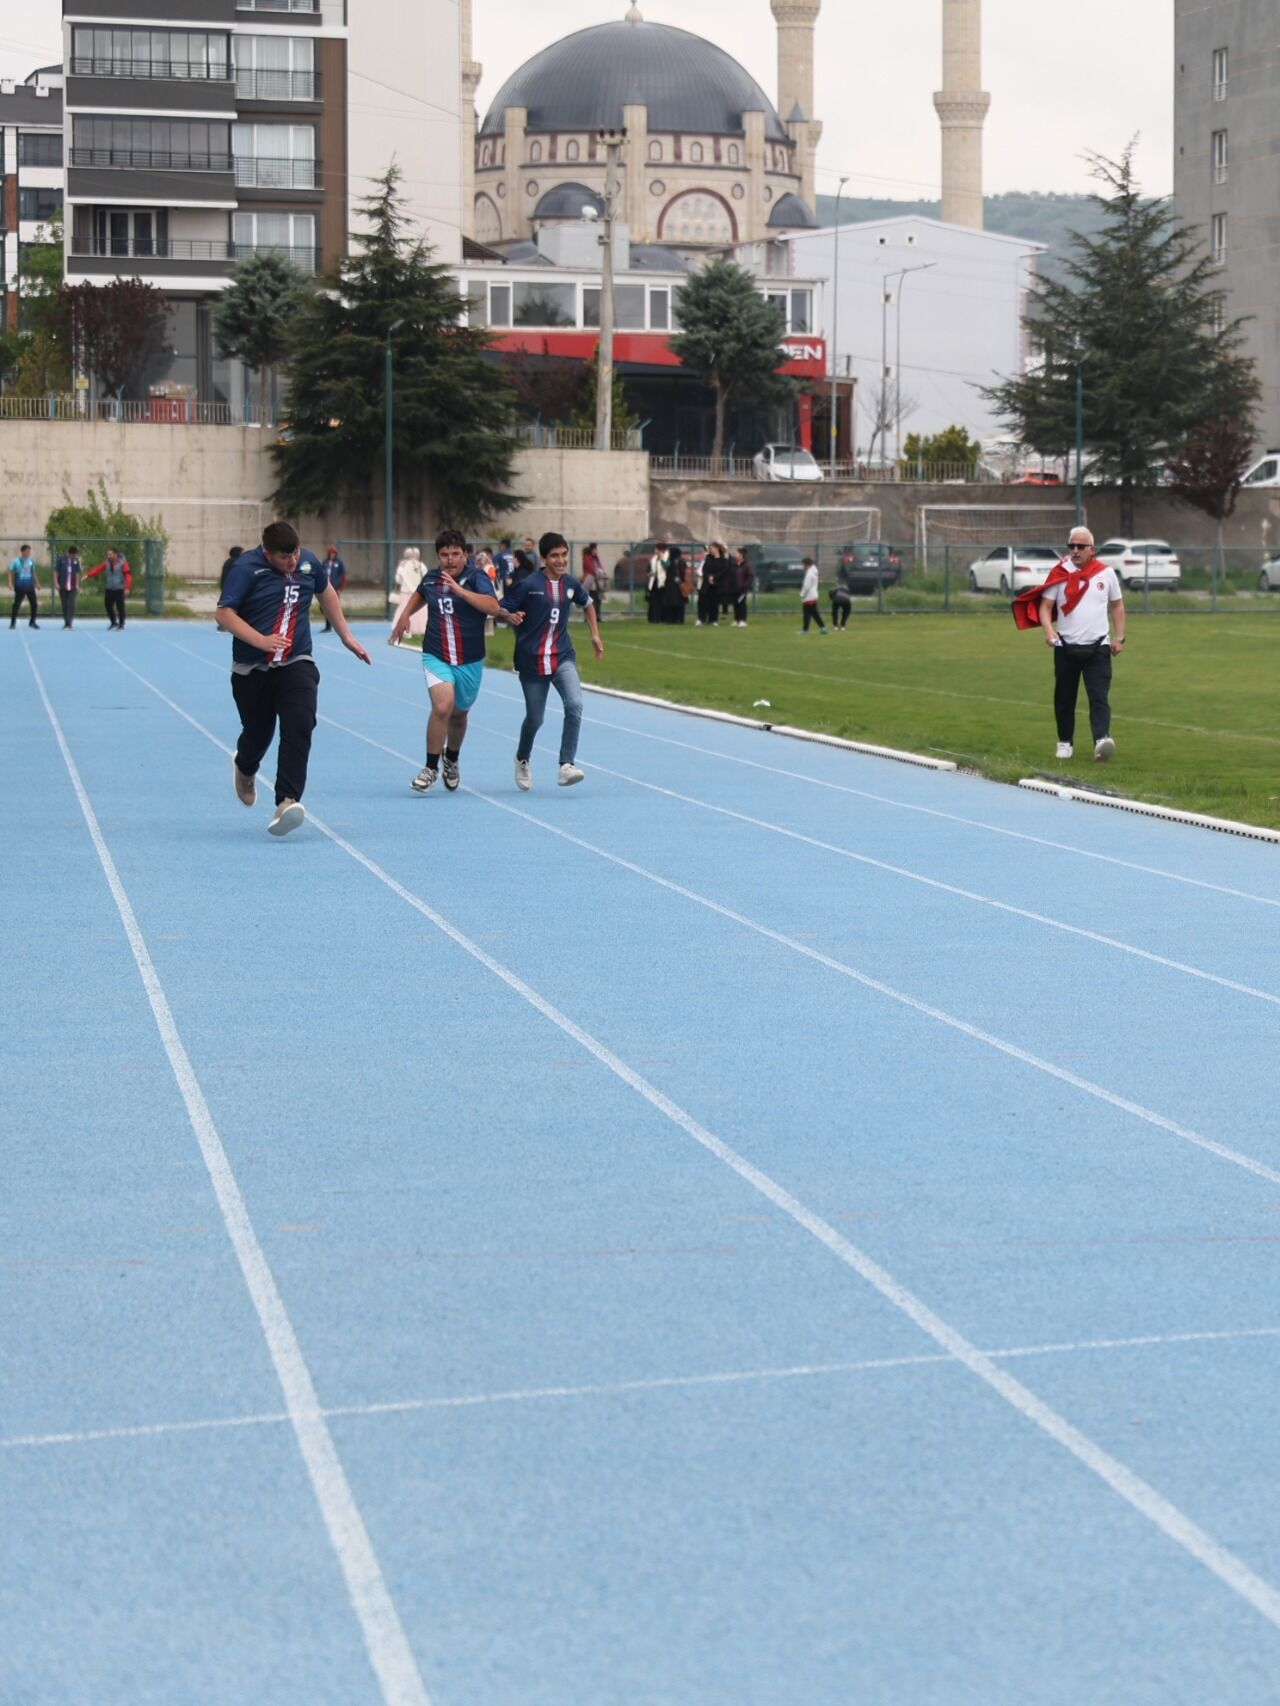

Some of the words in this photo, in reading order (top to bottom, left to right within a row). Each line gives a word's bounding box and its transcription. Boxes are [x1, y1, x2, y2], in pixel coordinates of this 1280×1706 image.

[283, 585, 300, 603] 15
[437, 598, 454, 615] 13
[550, 608, 561, 624] 9
